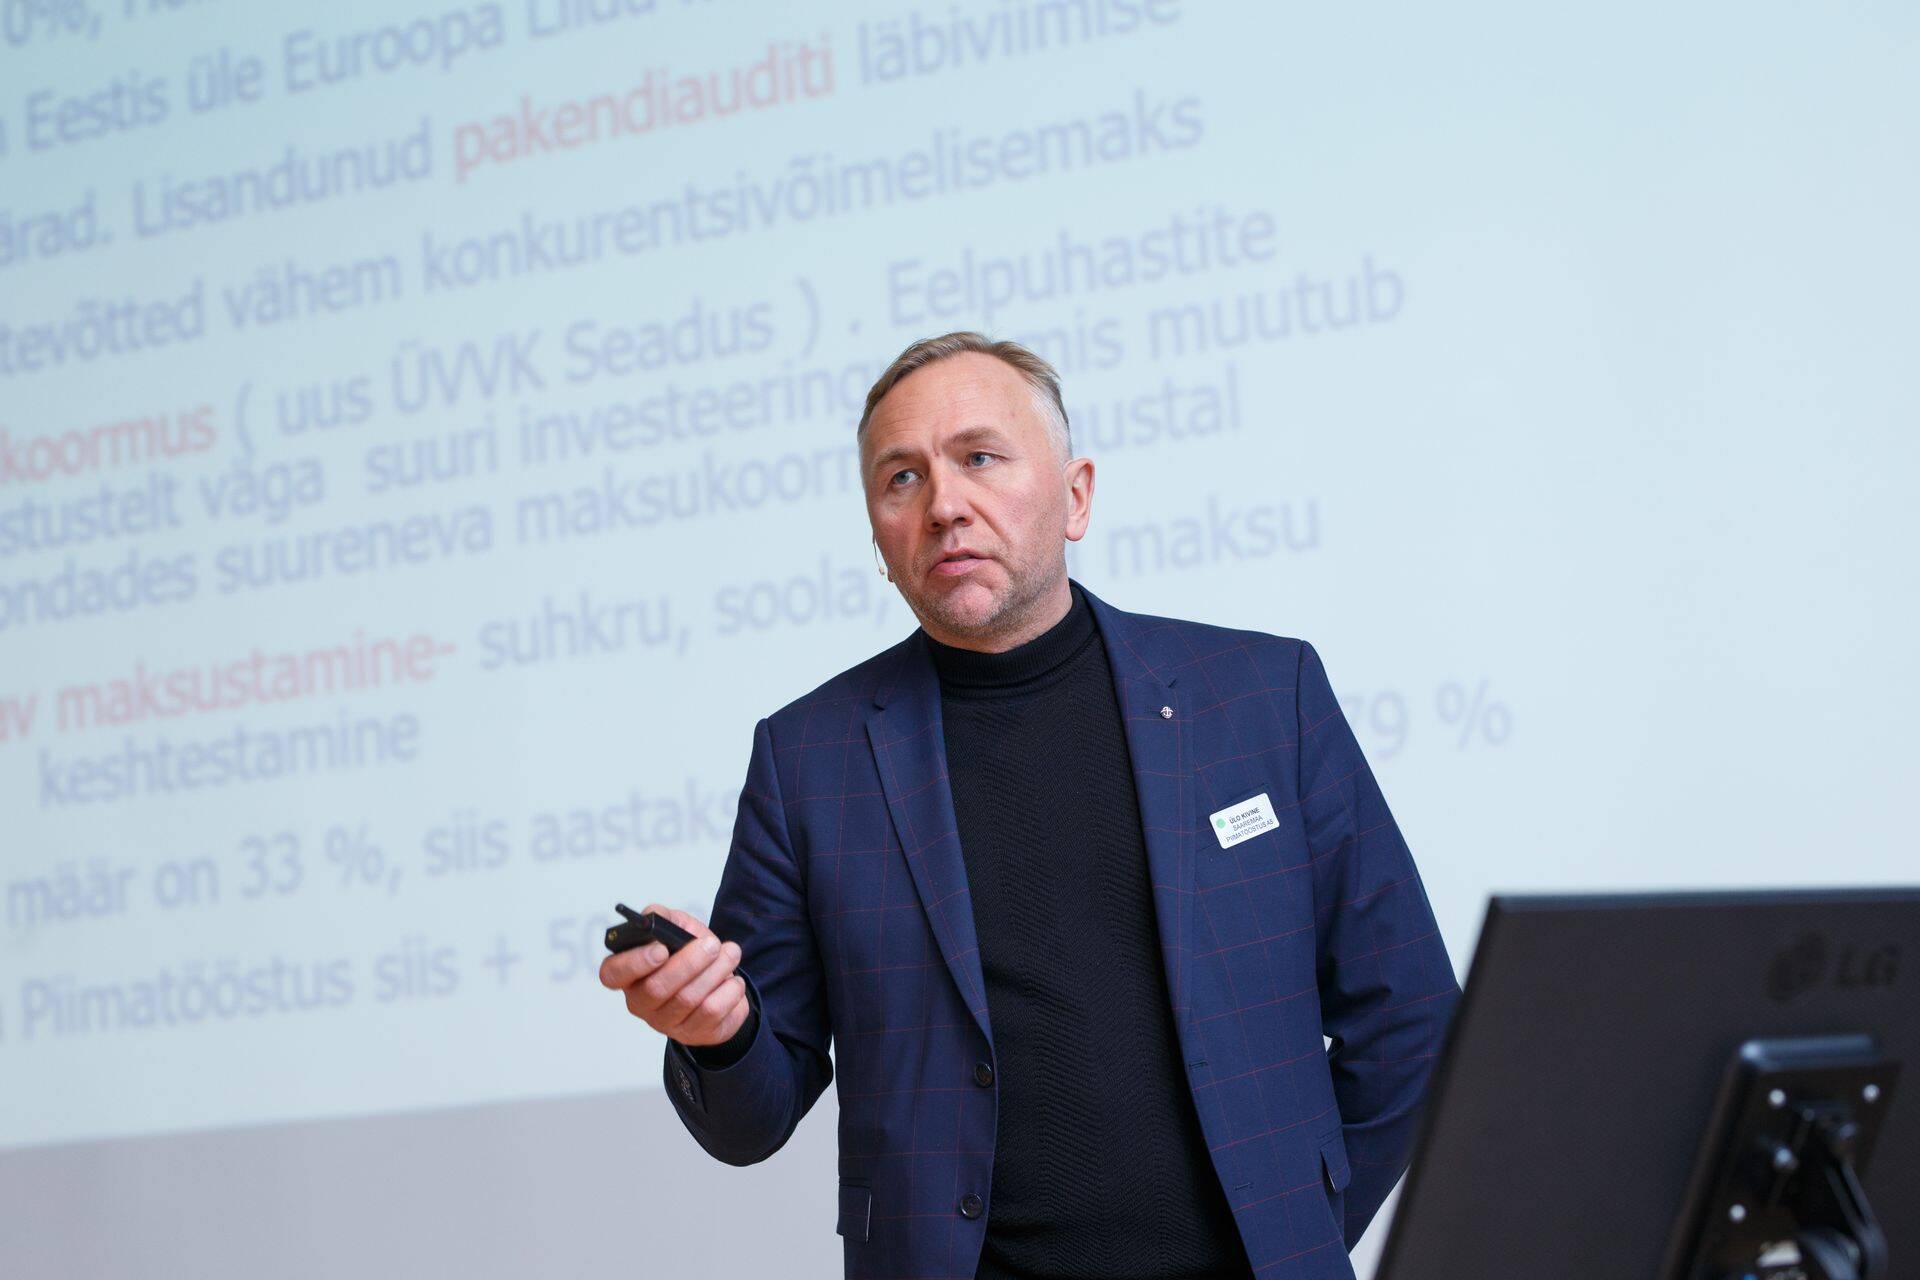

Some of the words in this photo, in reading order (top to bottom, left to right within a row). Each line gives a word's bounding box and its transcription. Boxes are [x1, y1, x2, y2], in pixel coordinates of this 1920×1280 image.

[25, 69, 171, 152] Eestis
[187, 45, 265, 114] üle
[282, 2, 505, 94] Euroopa
[132, 112, 434, 239] Lisandunud
[452, 32, 837, 185] pakendiauditi
[855, 0, 1184, 86] läbiviimise
[0, 274, 205, 377] tevõtted
[221, 253, 402, 329] vähem
[420, 88, 1206, 293] konkurentsivõimelisemaks
[275, 373, 374, 437] uus
[564, 291, 775, 385] Seadus
[885, 203, 1278, 333] Eelpuhastite
[198, 452, 326, 526] väga
[364, 408, 499, 495] suuri
[517, 358, 876, 468] investeering
[1146, 250, 1407, 362] muutub
[56, 627, 459, 733] maksustamine-
[477, 588, 692, 671] suhkru,
[712, 550, 891, 637] soola,
[1106, 493, 1323, 578] maksu
[214, 504, 494, 596] suureneva
[5, 855, 139, 928] määr
[153, 853, 220, 910] on
[237, 829, 305, 900] 33
[323, 820, 403, 898] %,
[422, 807, 511, 878] siis
[1436, 676, 1515, 750] %
[37, 704, 421, 808] keshtestamine
[1233, 816, 1263, 831] SAAREMAA
[1241, 807, 1260, 820] KIVINE
[20, 951, 356, 1041] Piimatööstus
[372, 932, 461, 1004] siis
